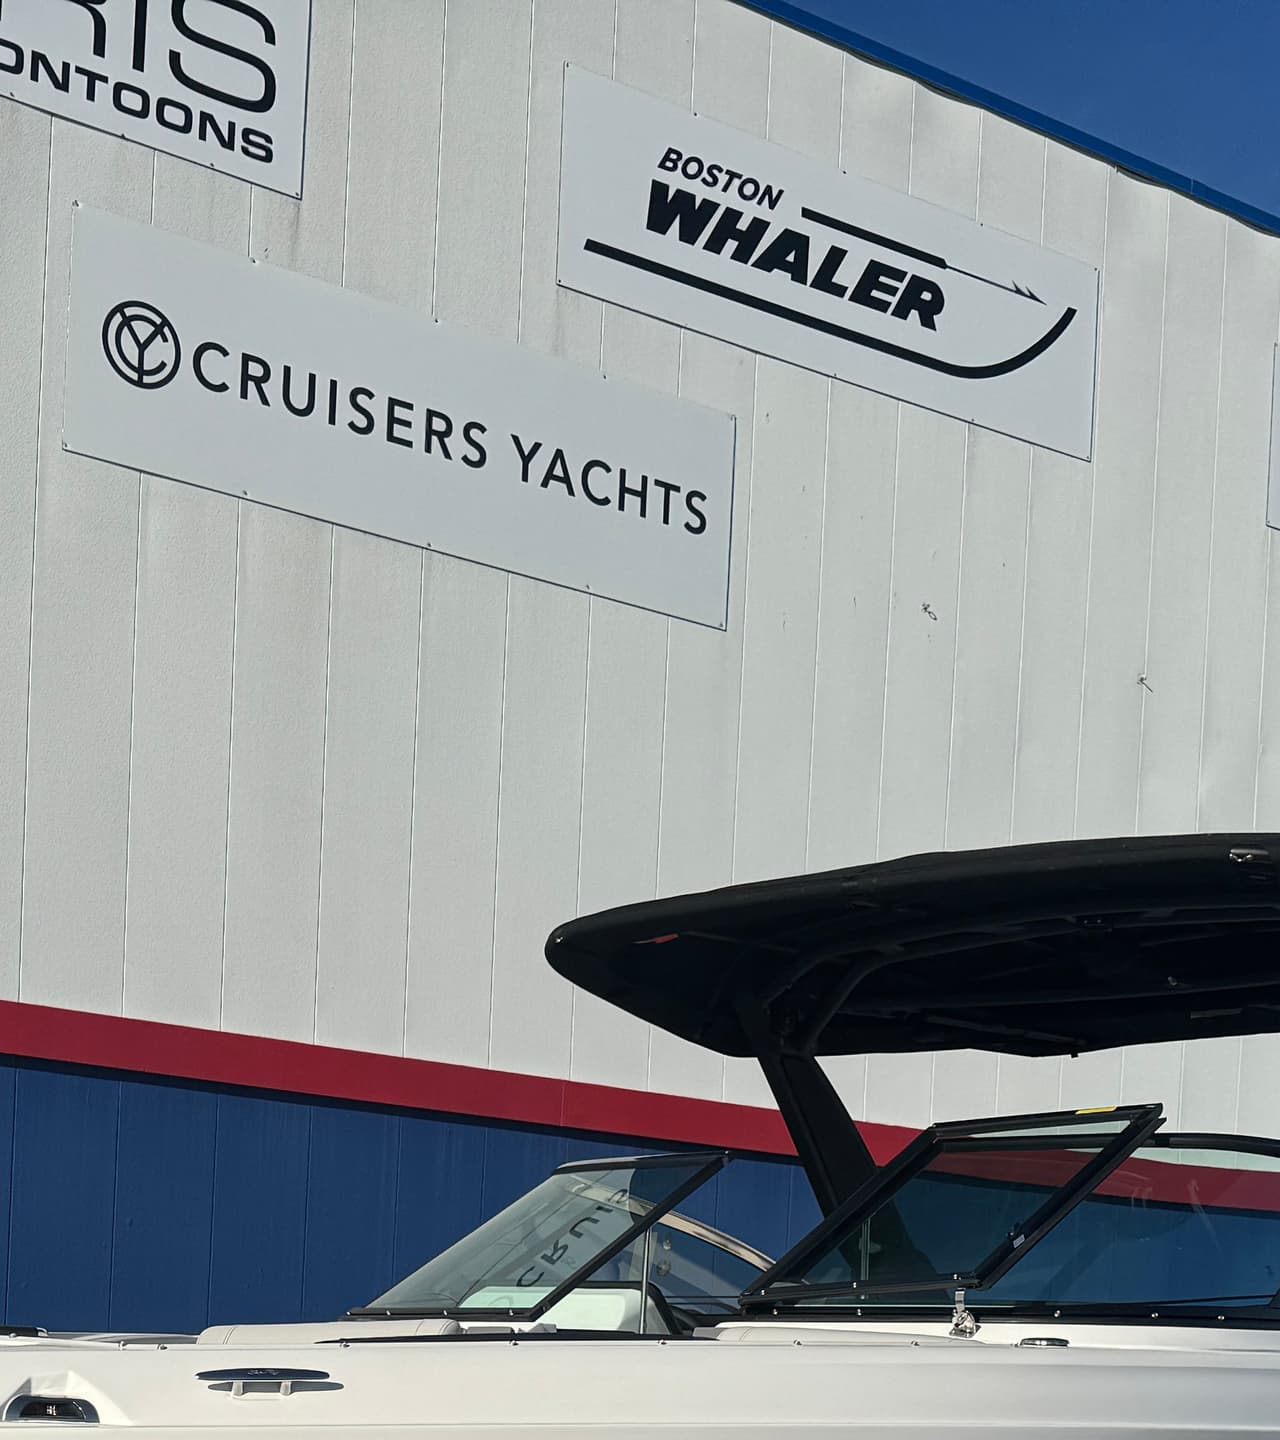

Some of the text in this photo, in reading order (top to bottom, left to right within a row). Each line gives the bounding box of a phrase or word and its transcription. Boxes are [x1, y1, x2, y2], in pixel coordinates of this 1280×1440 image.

[646, 179, 945, 332] WHALER
[657, 147, 785, 211] BOSTON
[192, 341, 707, 535] CRUISERS YACHTS
